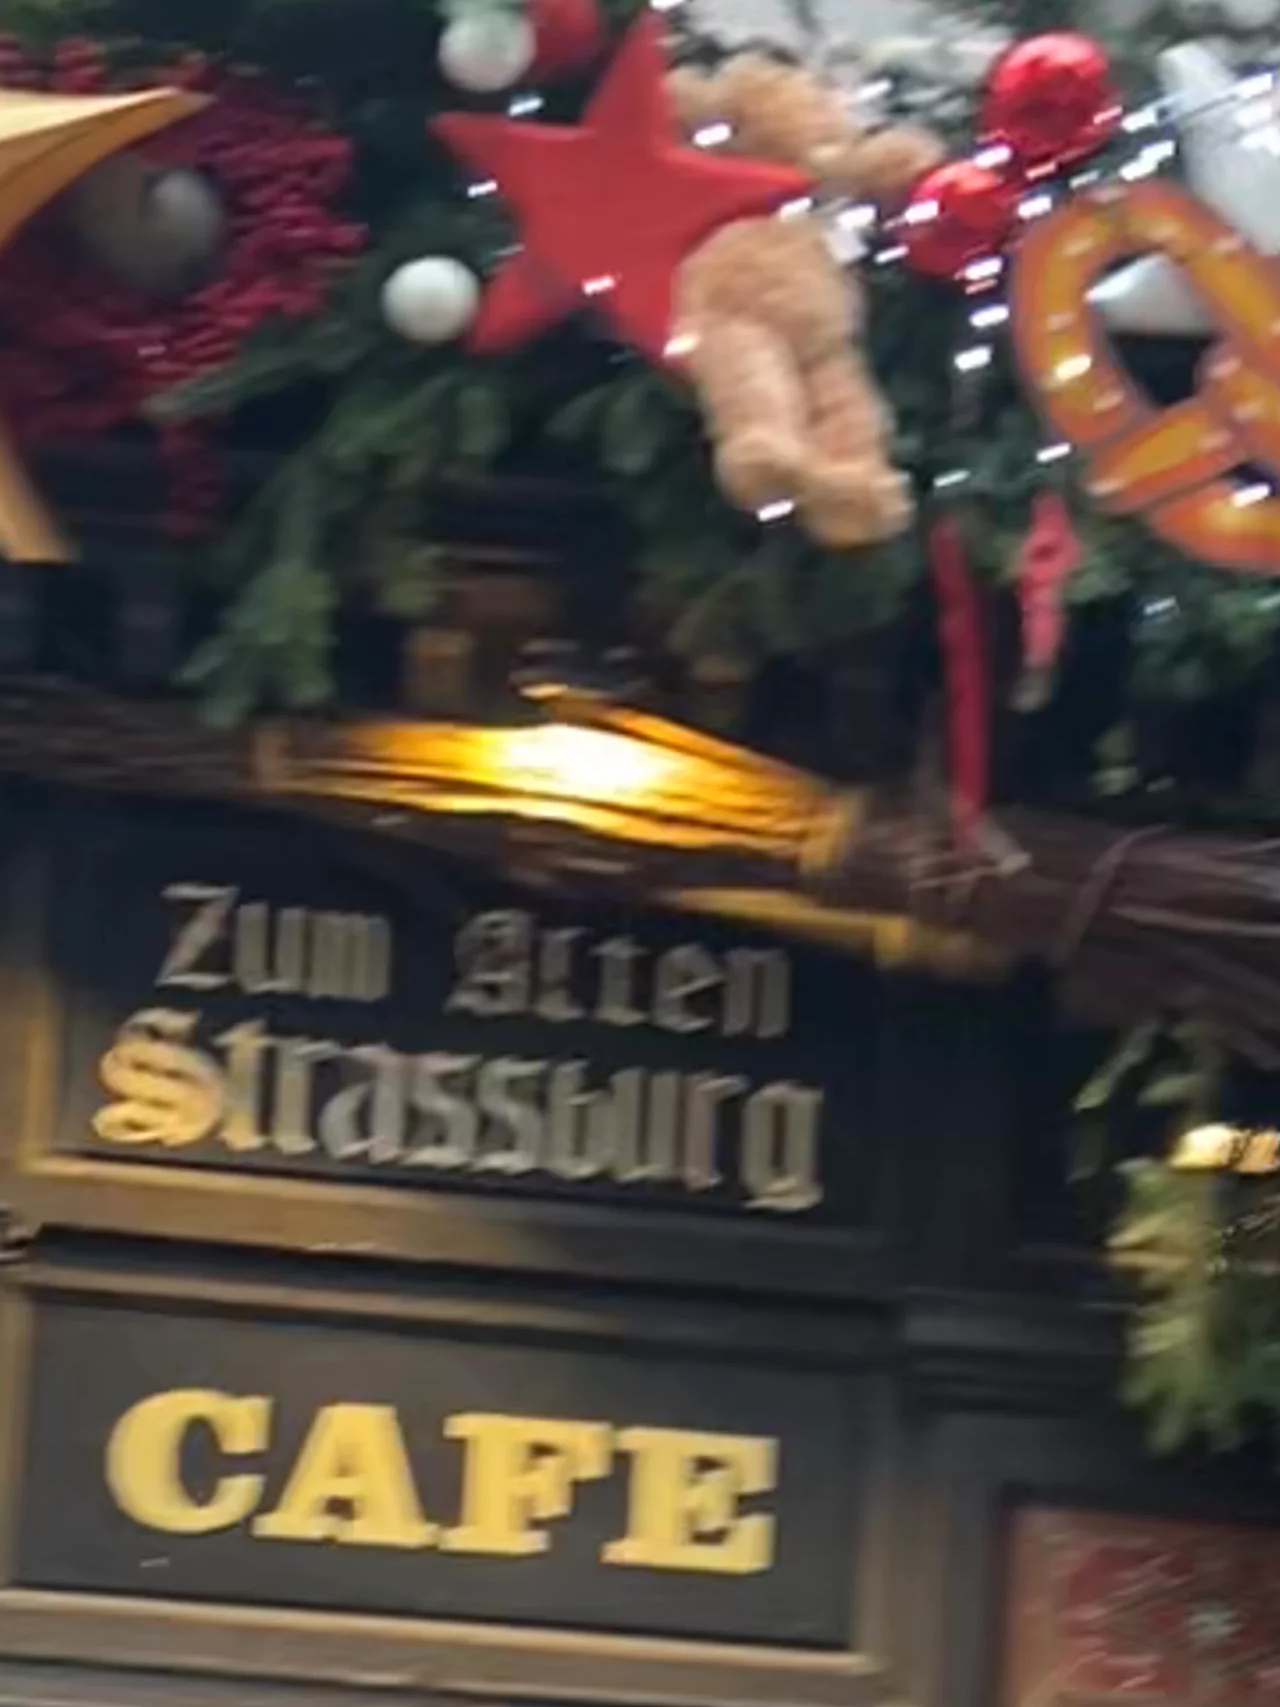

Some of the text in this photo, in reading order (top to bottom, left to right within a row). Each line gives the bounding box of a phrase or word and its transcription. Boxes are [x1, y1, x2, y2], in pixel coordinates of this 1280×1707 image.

[154, 881, 793, 1040] Zum Alten
[90, 1007, 826, 1213] Strassburg
[105, 1386, 779, 1574] CAFE
